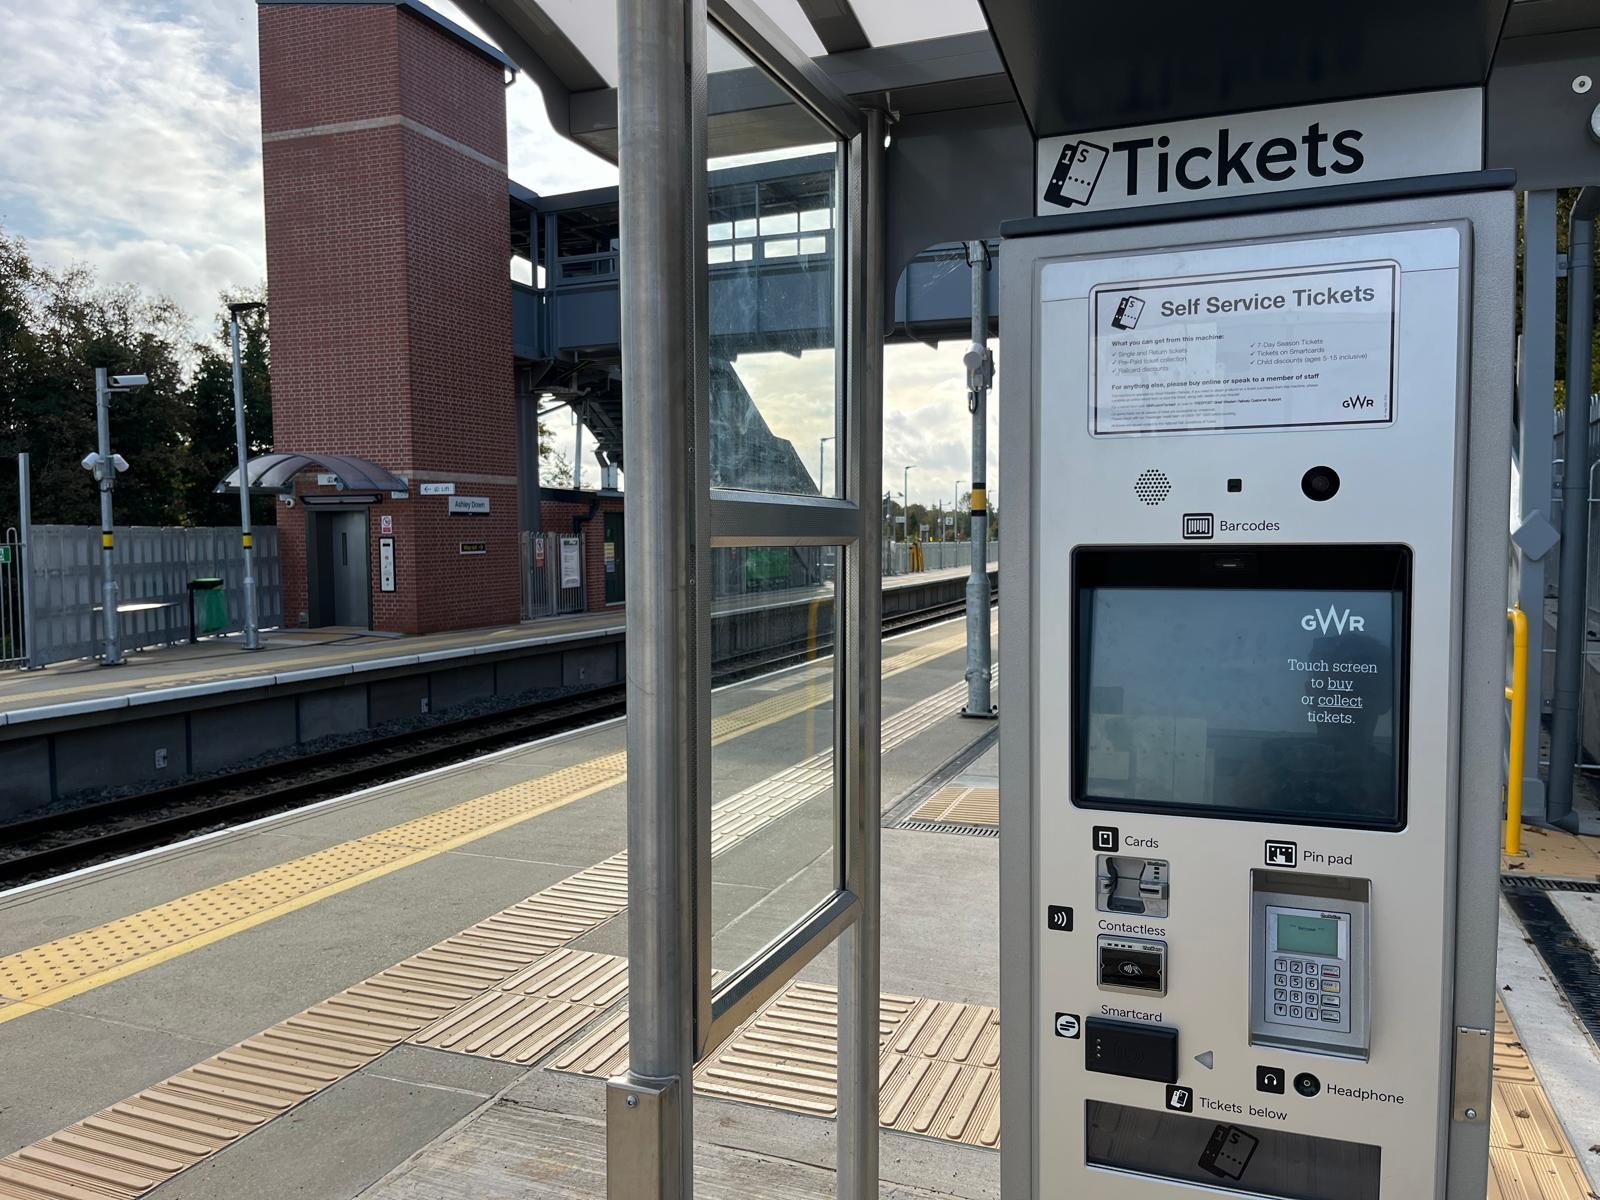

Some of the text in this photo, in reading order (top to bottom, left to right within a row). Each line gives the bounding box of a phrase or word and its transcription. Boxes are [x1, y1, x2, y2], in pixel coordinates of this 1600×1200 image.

[1112, 122, 1365, 197] Tickets
[1160, 285, 1375, 317] Self Service Tickets
[1289, 347, 1325, 355] Smartcards
[1304, 356, 1321, 364] (ages
[1339, 353, 1368, 361] inclusive)
[1123, 382, 1149, 390] anything
[1151, 381, 1166, 389] else,
[1166, 379, 1188, 388] please
[1189, 379, 1201, 388] buy
[1231, 376, 1251, 384] speak
[1342, 395, 1375, 409] GWR
[455, 500, 486, 509] Ashley Down
[1220, 520, 1280, 531] Barcodes
[1301, 603, 1365, 635] GWR
[1287, 659, 1378, 674] Touch screen
[1311, 677, 1354, 691] to buy
[1301, 694, 1363, 707] or collect
[1307, 711, 1356, 724] tickets.
[1124, 835, 1159, 849] Cards
[1303, 850, 1353, 867] Pin pad
[1098, 919, 1166, 937] Contactless
[1293, 963, 1299, 972] 2
[1309, 965, 1315, 974] 3
[1293, 978, 1299, 986] 5
[1309, 979, 1315, 988] 6
[1277, 991, 1315, 1003] 7 8 9
[1101, 1004, 1162, 1022] Smartcard
[1326, 1083, 1405, 1104] Headphone
[1199, 1096, 1288, 1121] Tickets below
